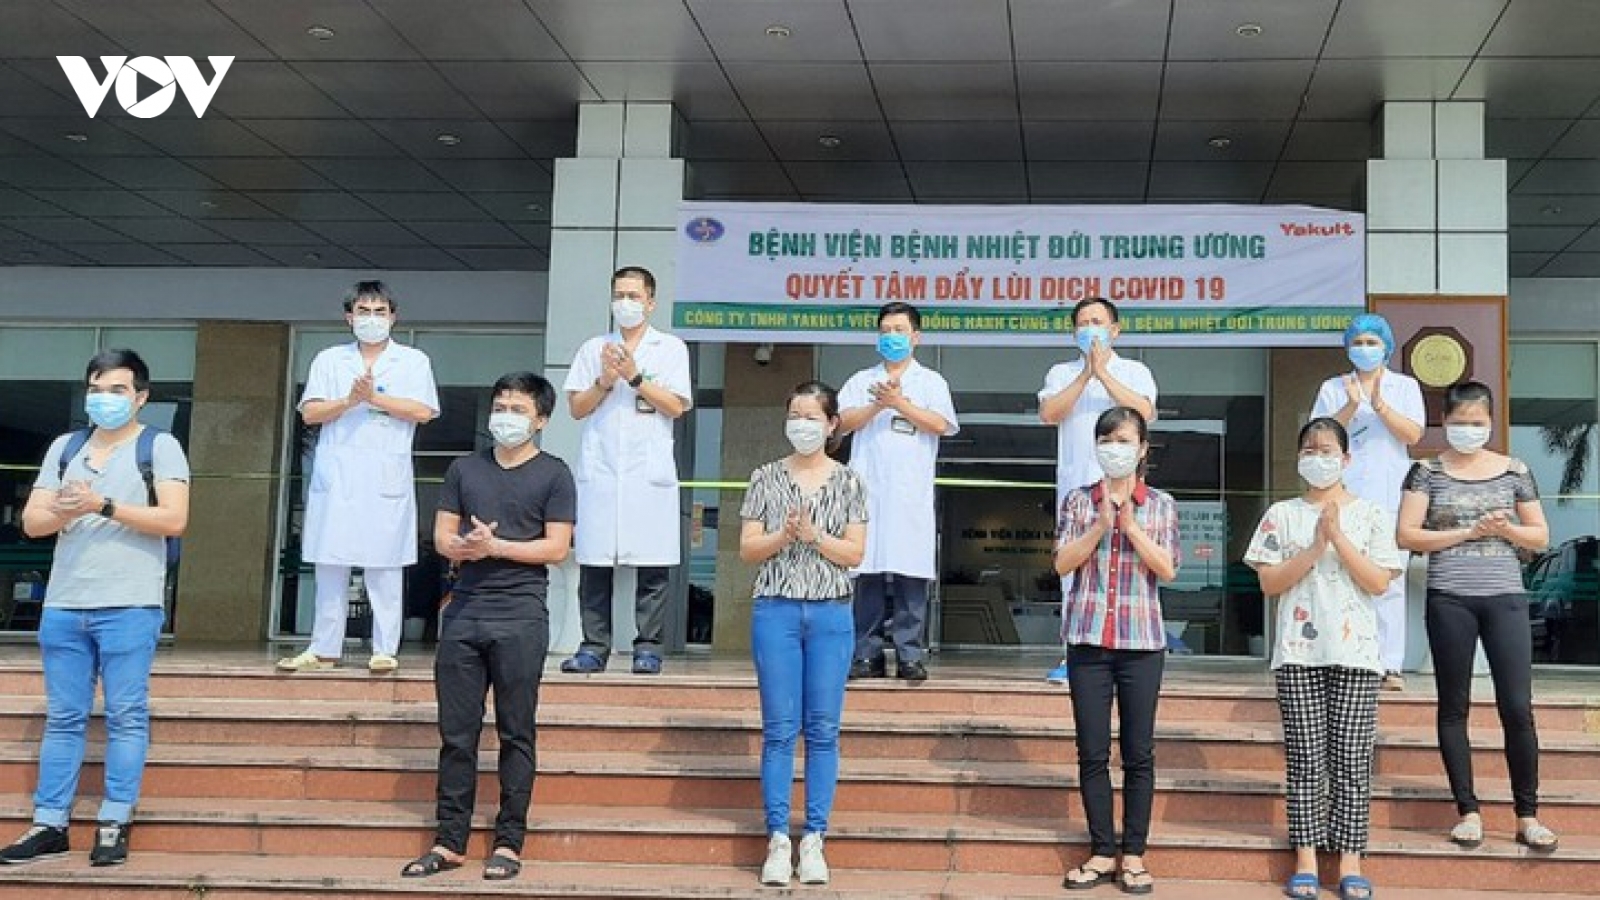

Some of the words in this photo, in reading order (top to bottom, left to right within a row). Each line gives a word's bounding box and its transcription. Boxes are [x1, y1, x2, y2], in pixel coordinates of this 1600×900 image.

[1280, 222, 1355, 236] Yakult
[749, 227, 816, 260] BỆNH
[824, 228, 882, 262] VIỆN
[891, 229, 958, 263] BỆNH
[966, 230, 1040, 264] NHIỆT
[1048, 230, 1091, 259] ĐỚI
[1100, 234, 1184, 259] TRUNG
[1193, 232, 1266, 259] ƯƠNG
[786, 267, 864, 300] QUYẾT
[873, 270, 927, 299] TÂM
[935, 267, 984, 300] ĐẨY
[993, 272, 1031, 300] LÙI
[1040, 275, 1100, 305] DỊCH
[1195, 276, 1226, 300] 19
[684, 309, 723, 325] CÔNG
[728, 312, 743, 325] TY
[750, 312, 788, 326] TNHH
[793, 313, 845, 328] YAKULT
[1258, 314, 1306, 329] TRUNG
